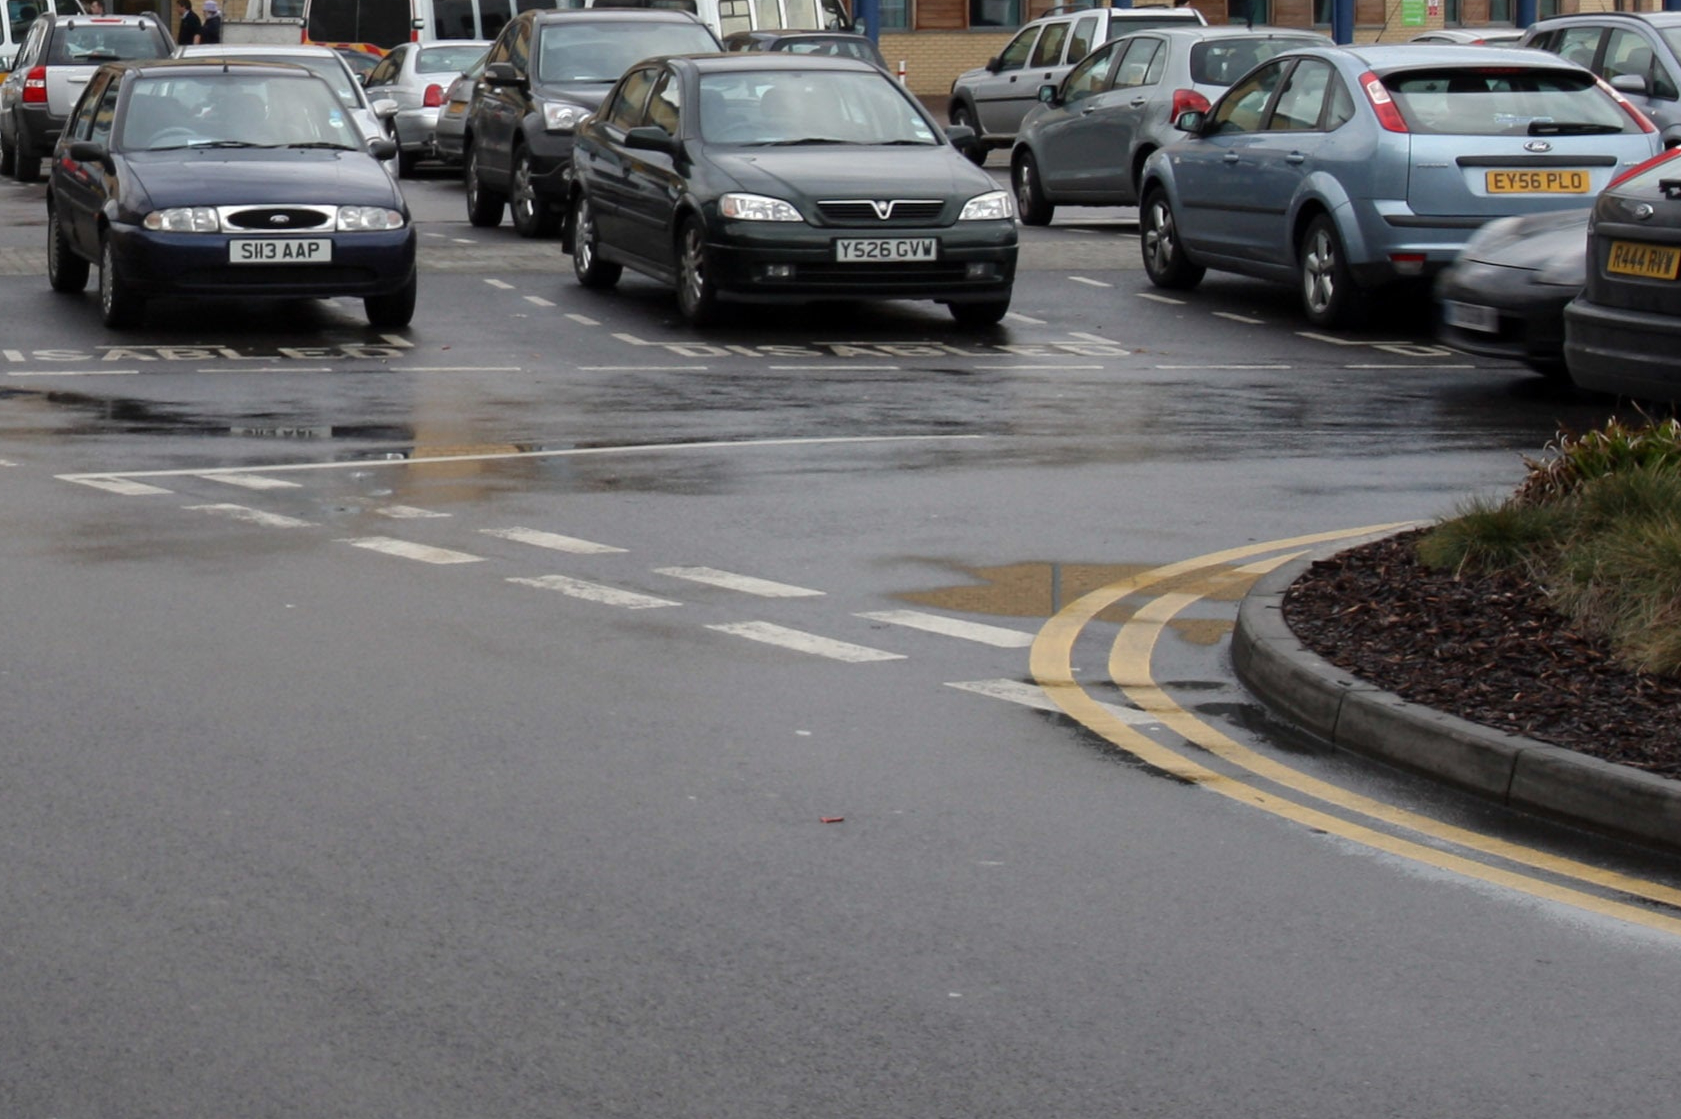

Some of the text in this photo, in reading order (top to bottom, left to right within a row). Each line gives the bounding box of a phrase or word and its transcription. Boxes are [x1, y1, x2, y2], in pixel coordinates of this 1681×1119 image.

[1493, 173, 1541, 189] EY56
[282, 242, 320, 258] AAP
[840, 241, 933, 258] Y526 GVW
[1612, 244, 1647, 271] R444
[663, 343, 1131, 358] DISABLED
